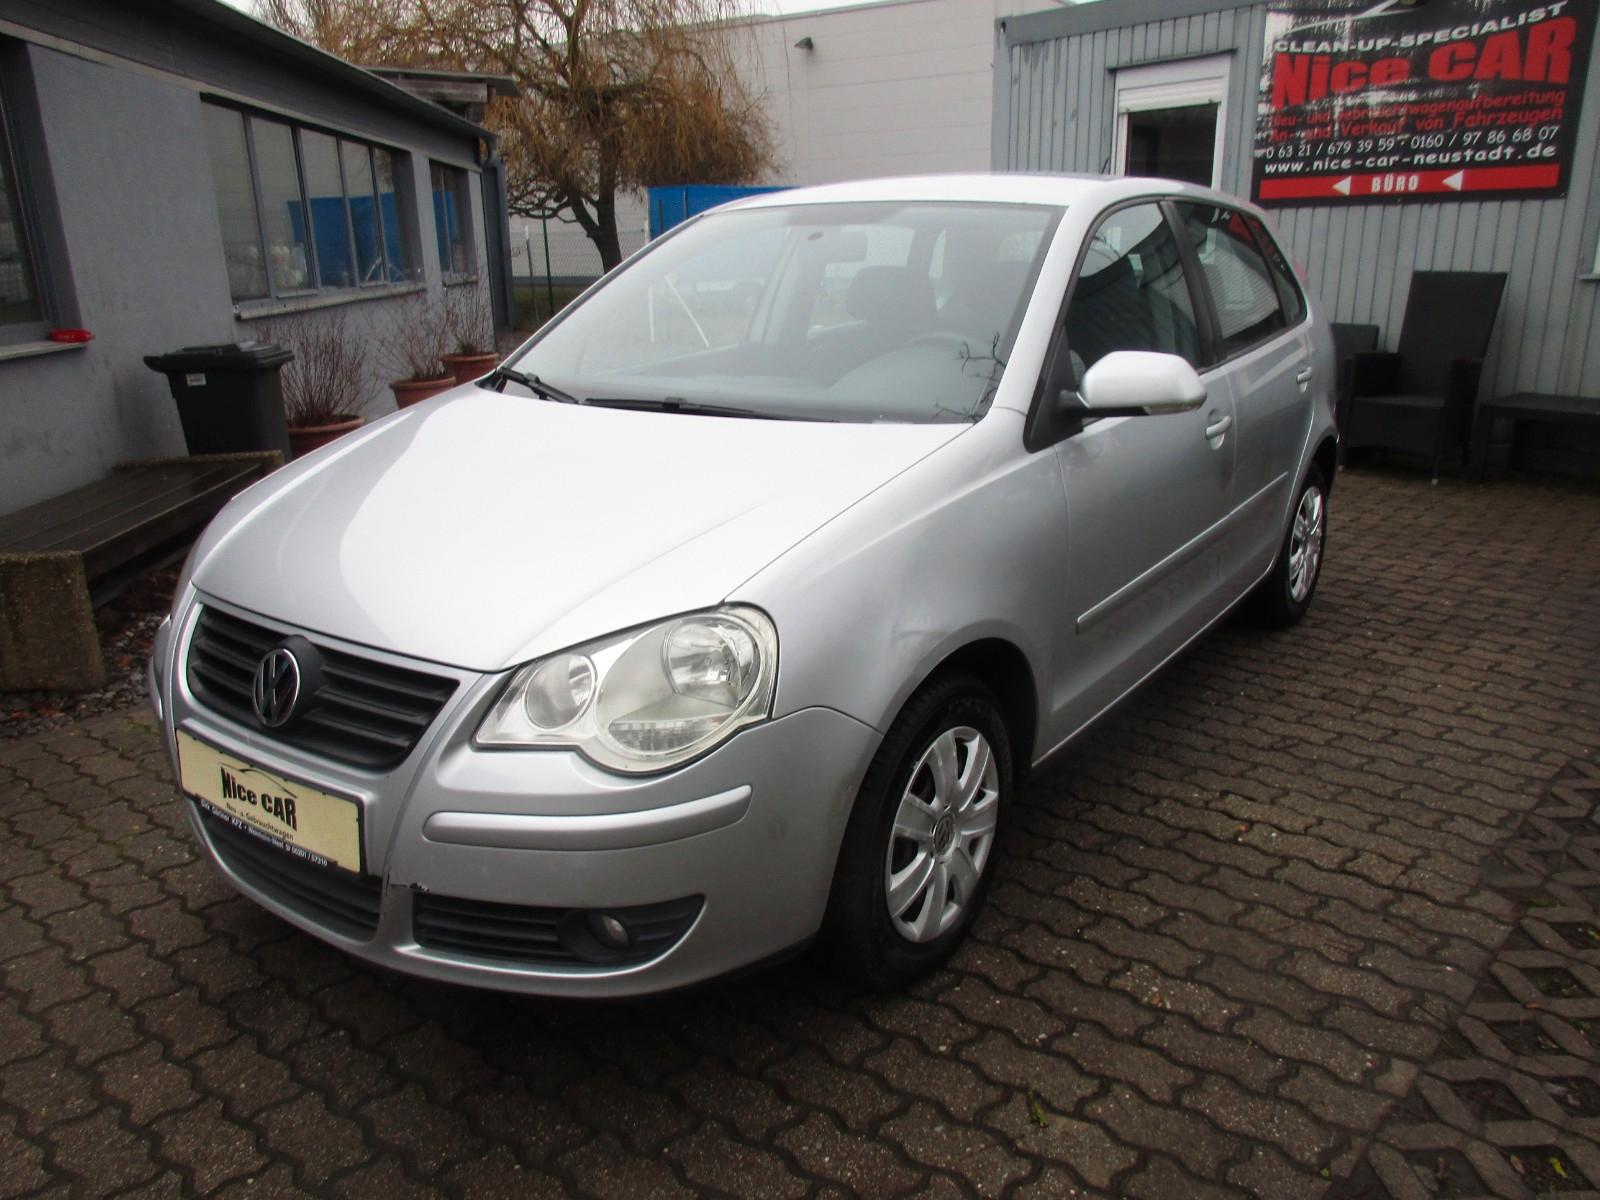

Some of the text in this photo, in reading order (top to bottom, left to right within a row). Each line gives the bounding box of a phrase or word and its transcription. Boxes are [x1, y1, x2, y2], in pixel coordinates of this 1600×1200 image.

[1274, 0, 1568, 52] CLEAN-UP-SPECIALIST
[1271, 16, 1576, 111] Nice CAR
[1341, 118, 1407, 137] Verkauf
[1415, 116, 1444, 131] von
[1452, 107, 1563, 129] Fahrzeugen
[1265, 142, 1557, 174] www.nice-car-neustadt.de
[1278, 145, 1292, 158] 63
[1299, 143, 1310, 157] 21
[1328, 140, 1351, 155] 679
[1358, 140, 1373, 153] 39
[1378, 138, 1395, 152] 59
[1411, 133, 1444, 149] 0160
[1448, 132, 1458, 147] /
[1463, 131, 1482, 146] 97
[1486, 129, 1506, 144] 86
[1512, 127, 1532, 142] 68
[1538, 125, 1561, 141] 07
[1371, 173, 1419, 193] BÜRO
[220, 766, 258, 806] Nice
[261, 793, 297, 833] CAR
